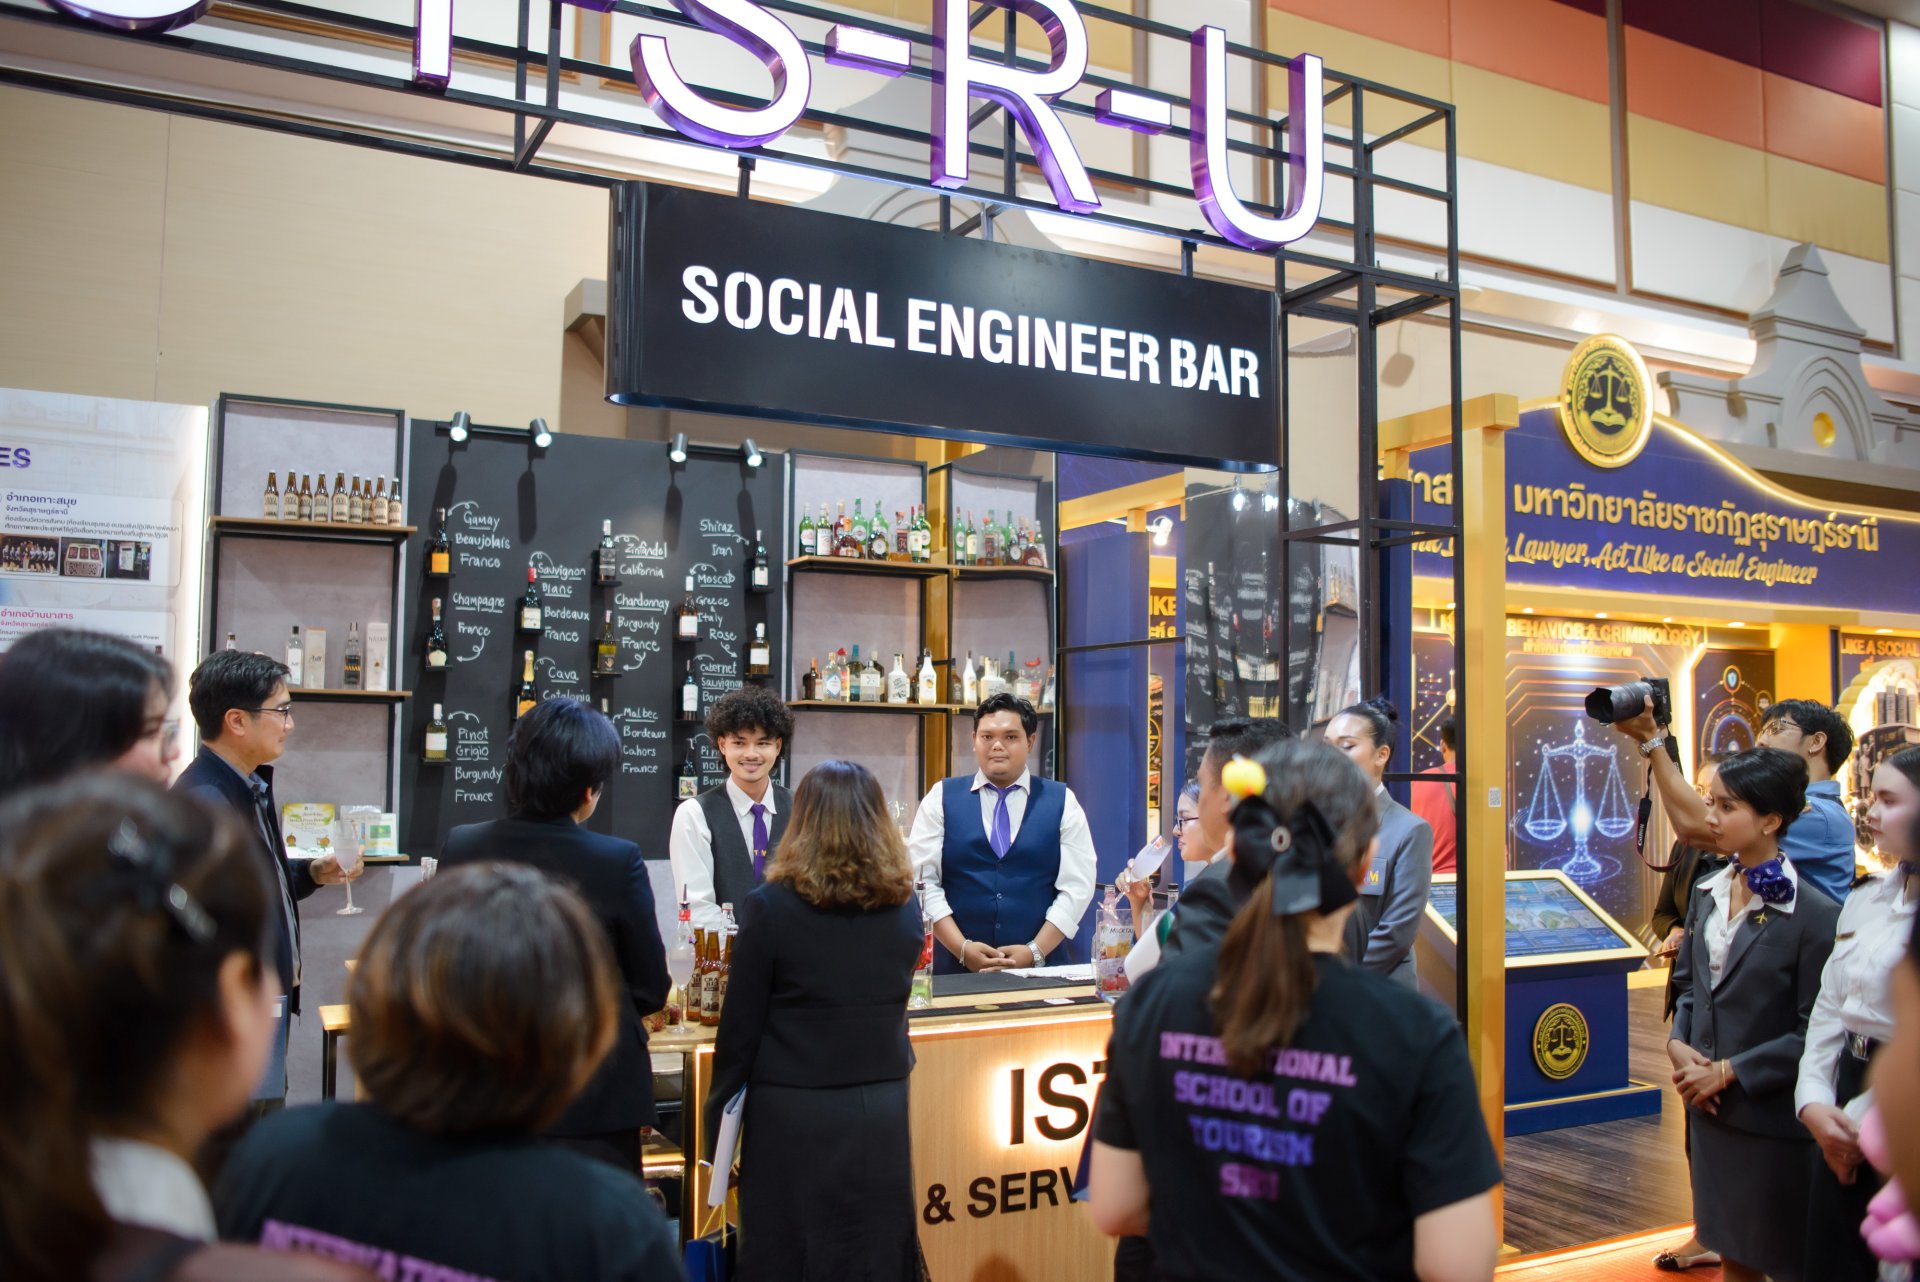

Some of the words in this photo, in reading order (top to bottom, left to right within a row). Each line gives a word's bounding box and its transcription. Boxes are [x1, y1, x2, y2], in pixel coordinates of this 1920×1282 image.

[681, 264, 895, 350] SOCIAL
[906, 297, 1162, 385] ENGINEER
[1169, 338, 1262, 400] BAR
[6, 491, 77, 508] อำเภอเกาะสมุย
[464, 511, 500, 532] Gamay
[700, 518, 735, 534] Shiraz
[1513, 482, 1879, 554] มหาวิทยาลัยราชภัฏสุราษฎร์ธานี
[455, 532, 511, 550] Beaujolais
[460, 552, 501, 568] France
[1591, 541, 1634, 571] Act
[1627, 544, 1671, 575] Like
[1671, 559, 1686, 574] a
[1686, 550, 1745, 578] Social
[1744, 556, 1819, 587] Engineer
[538, 562, 586, 581] Sauvignon
[619, 562, 665, 579] California
[453, 592, 505, 612] Champagne
[614, 592, 670, 616] Chardonnay
[696, 595, 730, 608] Greece
[1, 608, 74, 620] อำเภอบ้านนาสาร
[544, 606, 590, 622] Bordeaux
[458, 622, 491, 637] France
[544, 626, 580, 643] France
[618, 616, 660, 636] Burgundy
[622, 636, 661, 652] France
[1599, 624, 1701, 647] CRIMINOLOGY
[1840, 638, 1866, 655] LIKE
[1866, 640, 1876, 655] A
[1876, 640, 1920, 658] SOCIAL
[548, 666, 579, 681] Cava
[701, 676, 744, 692] Sauvignon
[623, 707, 659, 720] Malbec
[458, 727, 489, 741] Pinot
[623, 726, 667, 739] Bordeaux
[456, 745, 489, 762] Grigio
[622, 744, 657, 757] Cahors
[455, 766, 503, 785] Burgundy
[622, 762, 659, 774] France
[455, 789, 494, 803] France
[1173, 1069, 1281, 1119] SCHOOL
[1287, 1087, 1333, 1126] OF
[1188, 1113, 1314, 1167] TOURISM
[922, 1183, 957, 1226] &
